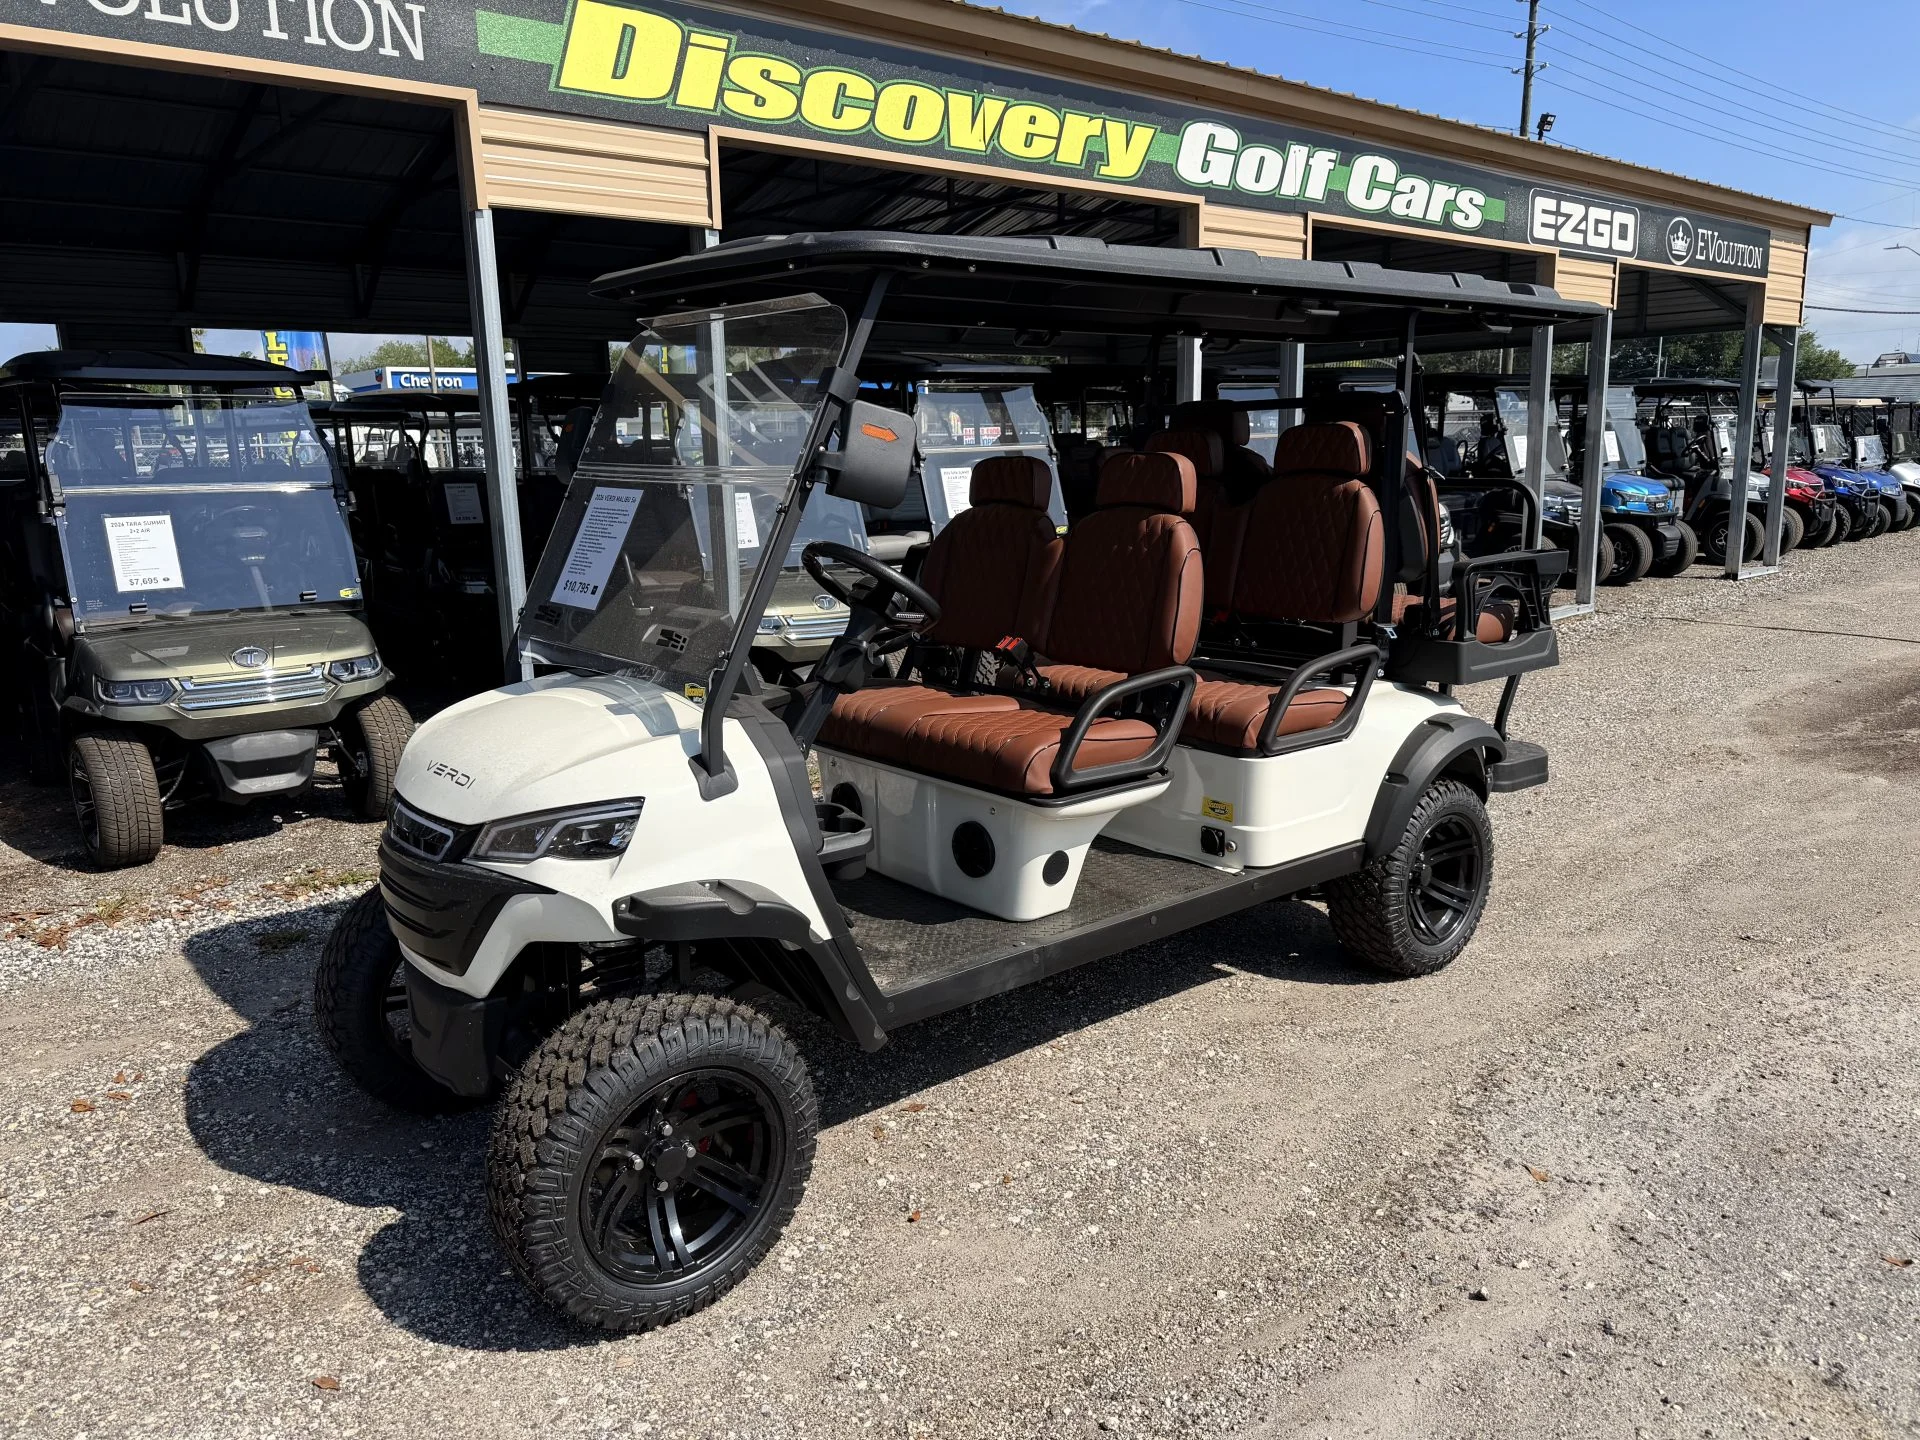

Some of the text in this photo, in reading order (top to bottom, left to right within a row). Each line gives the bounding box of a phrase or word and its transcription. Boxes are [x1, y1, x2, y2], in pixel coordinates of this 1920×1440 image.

[559, 0, 1486, 229] Discovery Golf Cars
[1532, 196, 1636, 253] EZGO
[1696, 228, 1763, 270] EVOLUTION
[129, 577, 159, 586] $7,695
[563, 580, 590, 594] $10,795
[426, 760, 476, 789] VERDI
